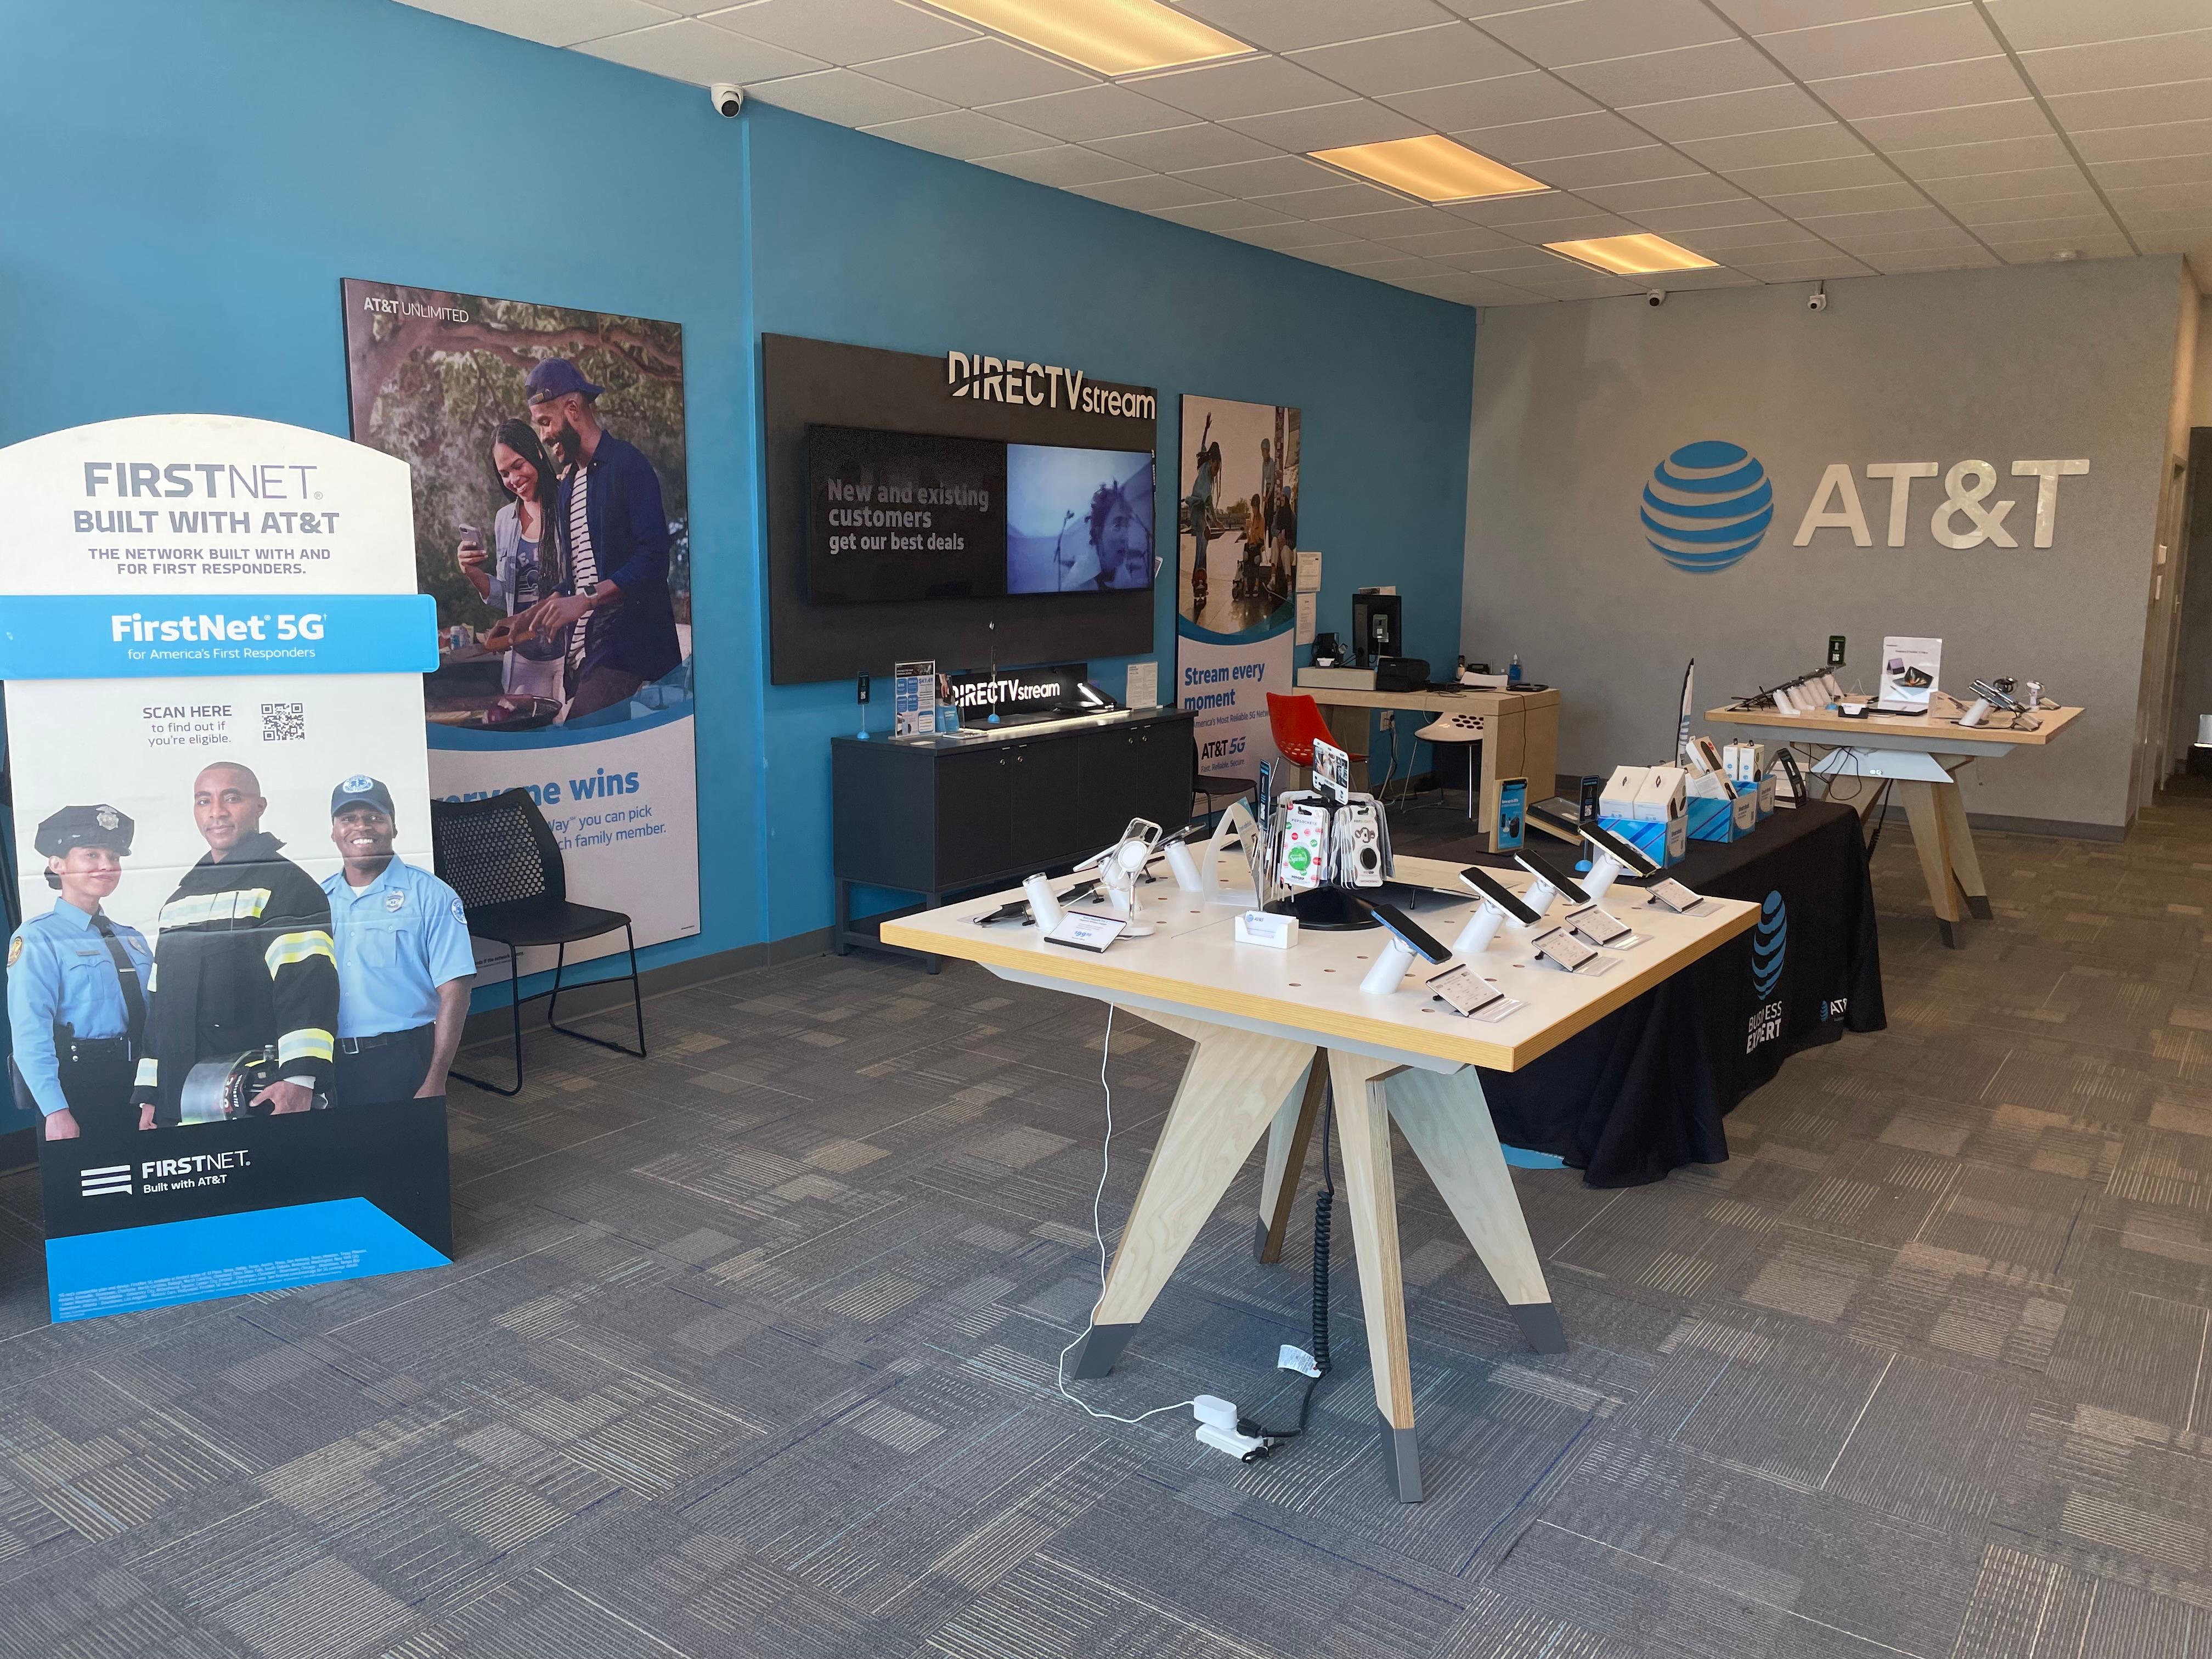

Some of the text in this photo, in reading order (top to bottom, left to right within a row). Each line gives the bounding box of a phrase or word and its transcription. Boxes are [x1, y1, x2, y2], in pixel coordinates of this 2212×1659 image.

[364, 297, 469, 323] AT&T UNLIMITED
[828, 478, 989, 512] New and existing
[1793, 459, 2090, 549] AT&T
[74, 510, 340, 534] BUILT WITH AT&T
[828, 507, 932, 528] customers
[88, 548, 331, 560] THE NETWORK BUILT WITH AND
[830, 532, 964, 555] get our best deals
[117, 563, 307, 575] FOR FIRST RESPONDERS.
[127, 646, 315, 660] for America's First Responders
[1184, 663, 1265, 686] Stream every
[1184, 689, 1235, 711] moment
[143, 704, 233, 719] SCAN HERE
[1216, 715, 1229, 725] Most
[1230, 712, 1248, 723] Reliable
[1249, 711, 1256, 720] 5G
[151, 720, 226, 732] to find out if
[148, 732, 232, 747] you're eligible.
[1201, 736, 1246, 760] AT&T 5G
[569, 768, 639, 800] wins
[579, 816, 601, 831] you
[605, 814, 625, 825] can
[629, 804, 652, 821] pick
[575, 830, 612, 847] family
[616, 823, 667, 840] member.
[1289, 854, 1306, 864] Sprite
[1746, 1018, 1781, 1054] EXPERT
[143, 1175, 227, 1194] Built with AT&T
